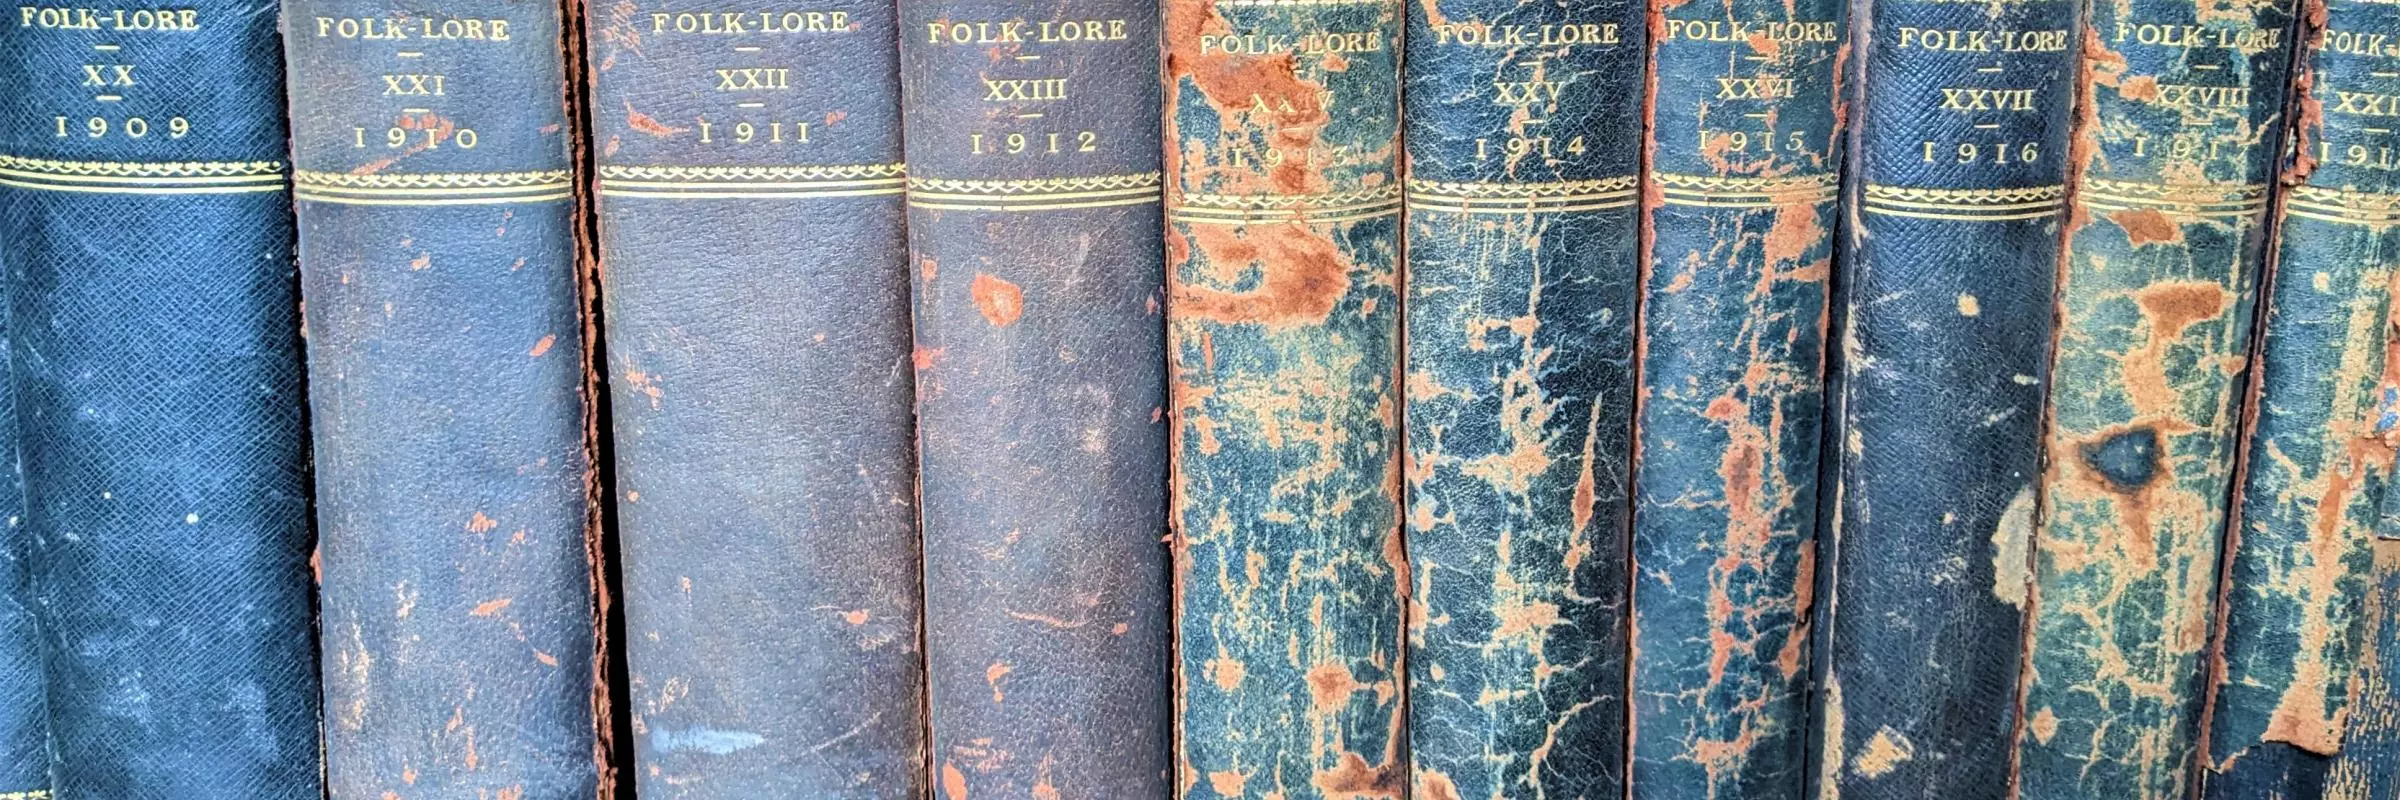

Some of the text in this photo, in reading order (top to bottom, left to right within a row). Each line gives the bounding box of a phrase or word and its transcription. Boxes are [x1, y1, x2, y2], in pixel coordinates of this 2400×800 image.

[20, 6, 200, 33] FOLK-LORE
[317, 16, 510, 41] FOLK-LORE
[651, 10, 851, 34] FOLK-LORE
[927, 19, 1128, 44] FOLK-LORE
[1667, 19, 1838, 42] FOLK-LORE
[1200, 31, 1382, 55] FOLK-LORE
[1437, 23, 1619, 46] FOLK-LORE
[1898, 27, 2068, 52] FOLK-LORE
[2114, 21, 2283, 49] FOLK-LORE
[2319, 29, 2400, 57] FOLK-
[382, 74, 446, 96] XXI
[716, 68, 789, 91] XXII
[983, 79, 1067, 101] XXIII
[1715, 78, 1795, 99] XXVI
[1250, 90, 1334, 113] XXV
[1493, 81, 1565, 103] XXV
[1939, 88, 2033, 110] XXVII
[2147, 84, 2252, 108] XXVIII
[2333, 91, 2400, 117] XXI
[2319, 141, 2400, 170] 191
